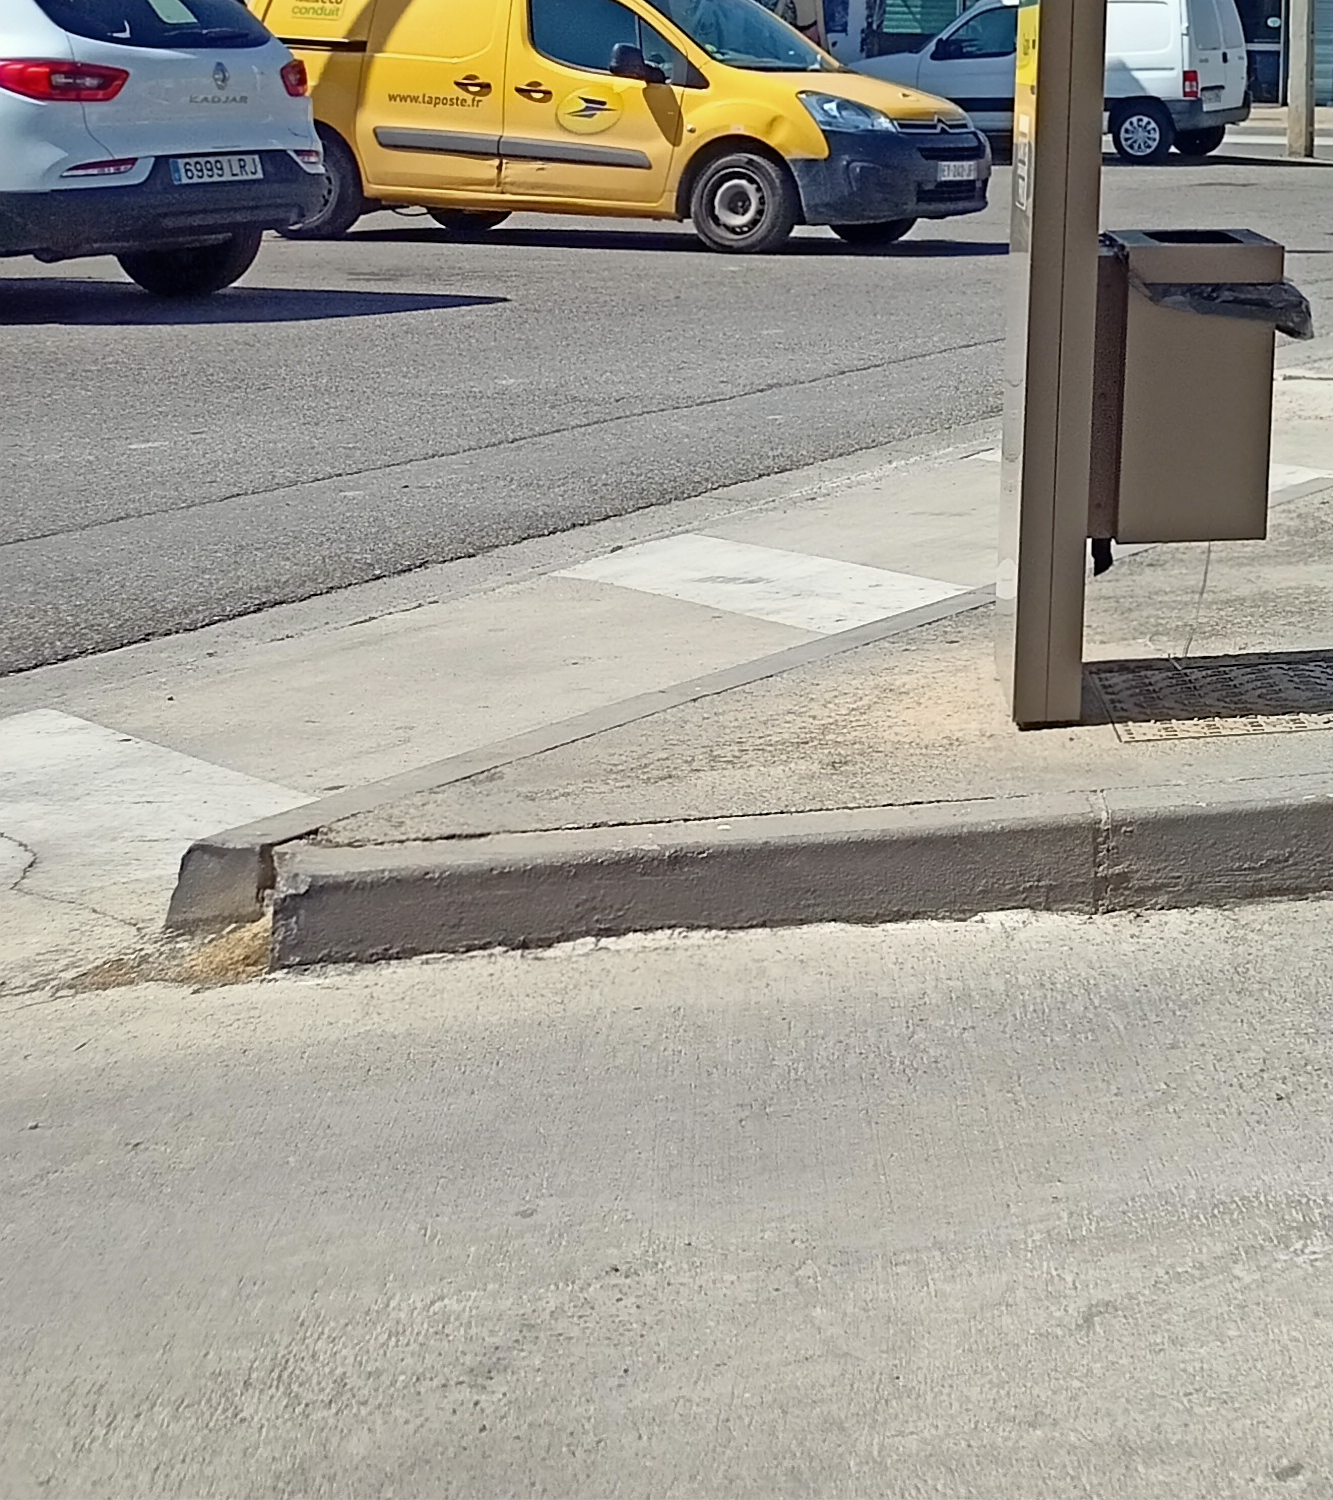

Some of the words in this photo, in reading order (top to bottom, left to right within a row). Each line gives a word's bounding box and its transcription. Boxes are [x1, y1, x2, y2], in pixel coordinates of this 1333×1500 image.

[291, 5, 341, 17] conduit
[189, 94, 249, 105] KADJAR
[387, 92, 483, 109] www.laposte.fr
[183, 159, 225, 181] 6999
[227, 156, 259, 178] LRJ
